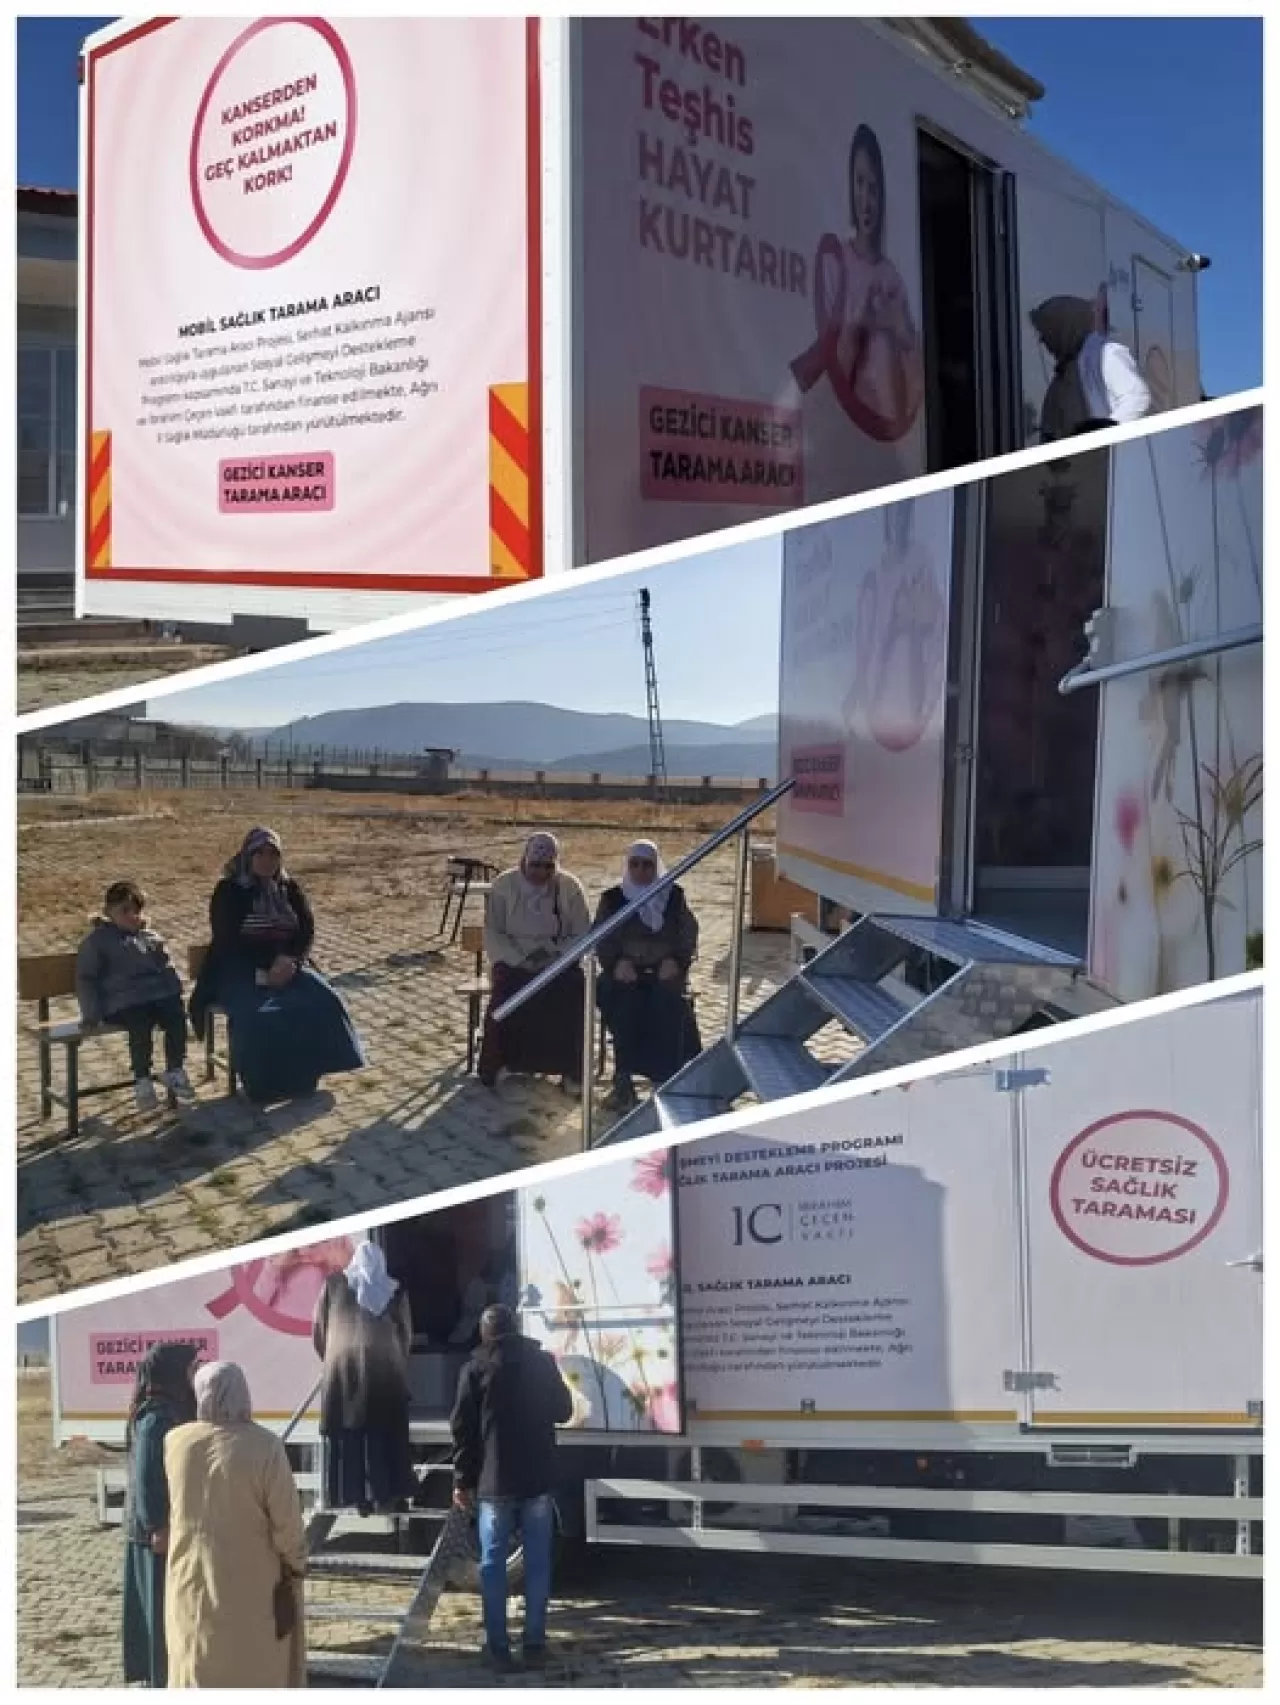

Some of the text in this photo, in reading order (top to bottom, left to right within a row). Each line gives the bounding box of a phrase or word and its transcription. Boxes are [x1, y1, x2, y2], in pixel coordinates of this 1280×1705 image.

[221, 73, 318, 126] KANSERDEN
[634, 52, 754, 156] Teşhis
[231, 106, 306, 147] KORKMA!
[204, 120, 338, 183] GEÇ KALMAKTAN
[243, 164, 293, 194] KORK!
[638, 129, 756, 220] HAYAT
[638, 194, 808, 298] KURTARIR
[178, 285, 381, 338] MOBİL SAĞLIK TARAMA ARACI
[650, 403, 716, 439] GEZİCİ
[223, 461, 325, 482] GEZİCİ KANSER
[649, 450, 797, 488] TARAMA ARACI
[223, 484, 327, 504] TARAMA ARACI
[724, 1142, 816, 1164] DESTEKLEME
[820, 1135, 904, 1154] PROGRAMI
[1081, 1149, 1198, 1177] ÜCRETSİZ
[712, 1166, 771, 1184] TARAMA
[775, 1162, 821, 1177] ARACI
[824, 1152, 888, 1172] PROJESİ
[1090, 1175, 1178, 1199] SAĞLIK
[1071, 1198, 1197, 1225] TARAMASI
[698, 1279, 743, 1293] SAĞLIK
[747, 1276, 804, 1290] TARAMA
[807, 1273, 852, 1285] ARACI
